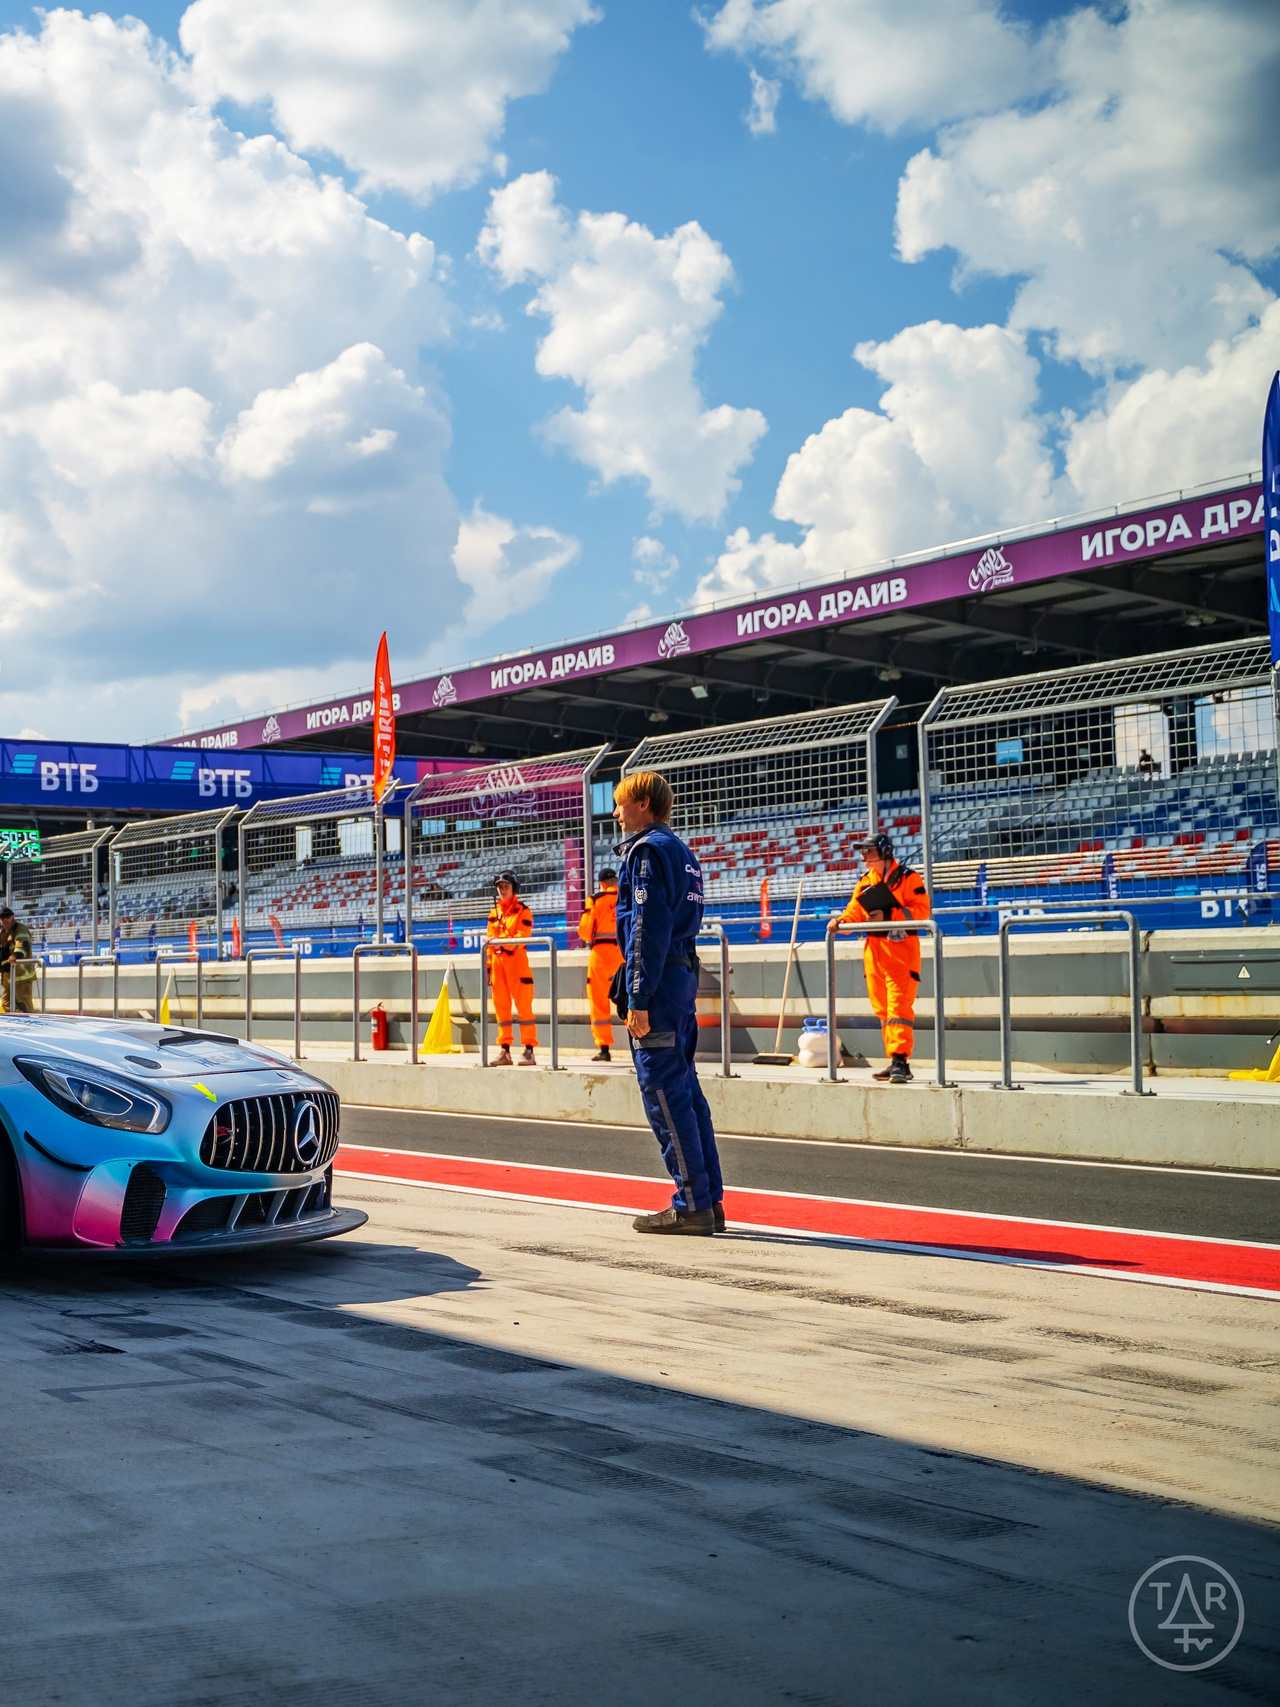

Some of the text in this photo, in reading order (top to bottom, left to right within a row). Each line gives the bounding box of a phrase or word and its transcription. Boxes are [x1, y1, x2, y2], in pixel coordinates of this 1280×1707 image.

[1081, 514, 1192, 561] ИГОРА
[1200, 495, 1265, 539] ДРА
[736, 577, 908, 636] ИГОРА ДРАЙВ
[490, 644, 615, 690] ИГОРА ДРАЙВ
[306, 706, 351, 730] ИГОРА
[40, 761, 99, 794] ВТБ
[198, 768, 253, 798] ВТБ
[344, 774, 395, 803] ВТ
